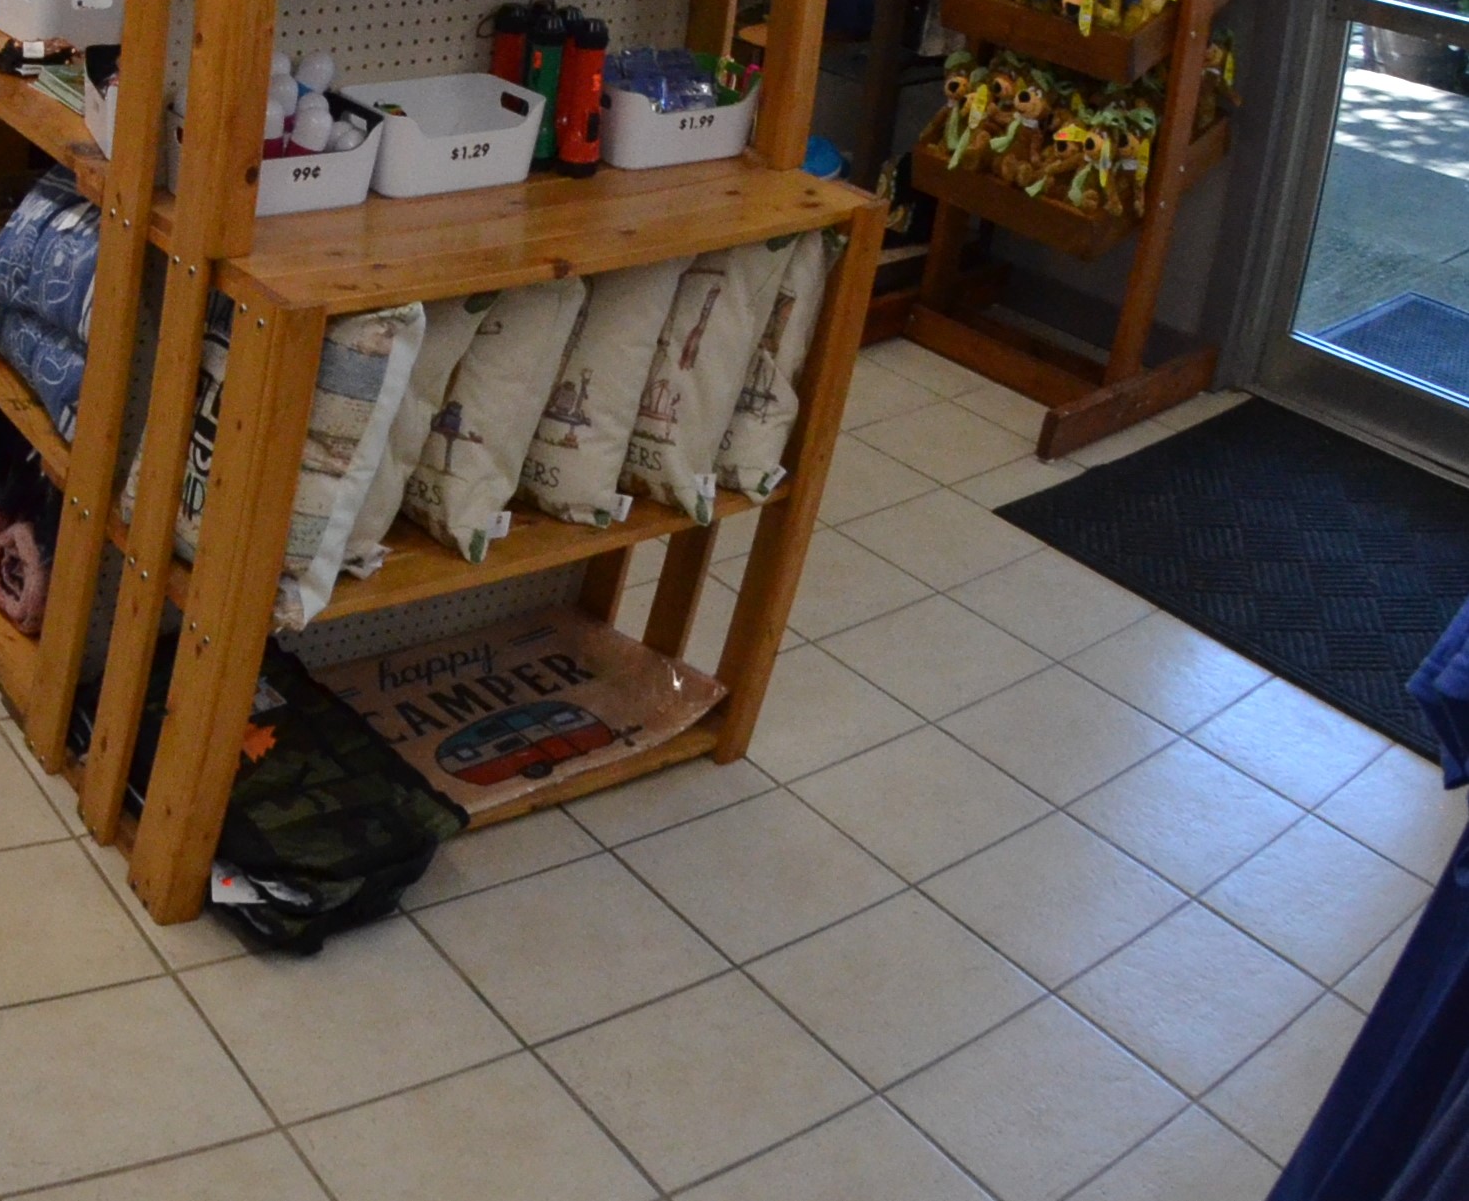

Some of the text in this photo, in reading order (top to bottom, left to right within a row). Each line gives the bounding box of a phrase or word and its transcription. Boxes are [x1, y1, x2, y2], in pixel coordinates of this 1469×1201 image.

[678, 114, 715, 131] $1.99
[450, 142, 491, 161] $1.29
[292, 165, 321, 182] 99¢
[378, 642, 496, 692] happy
[363, 653, 595, 745] CAMPER
